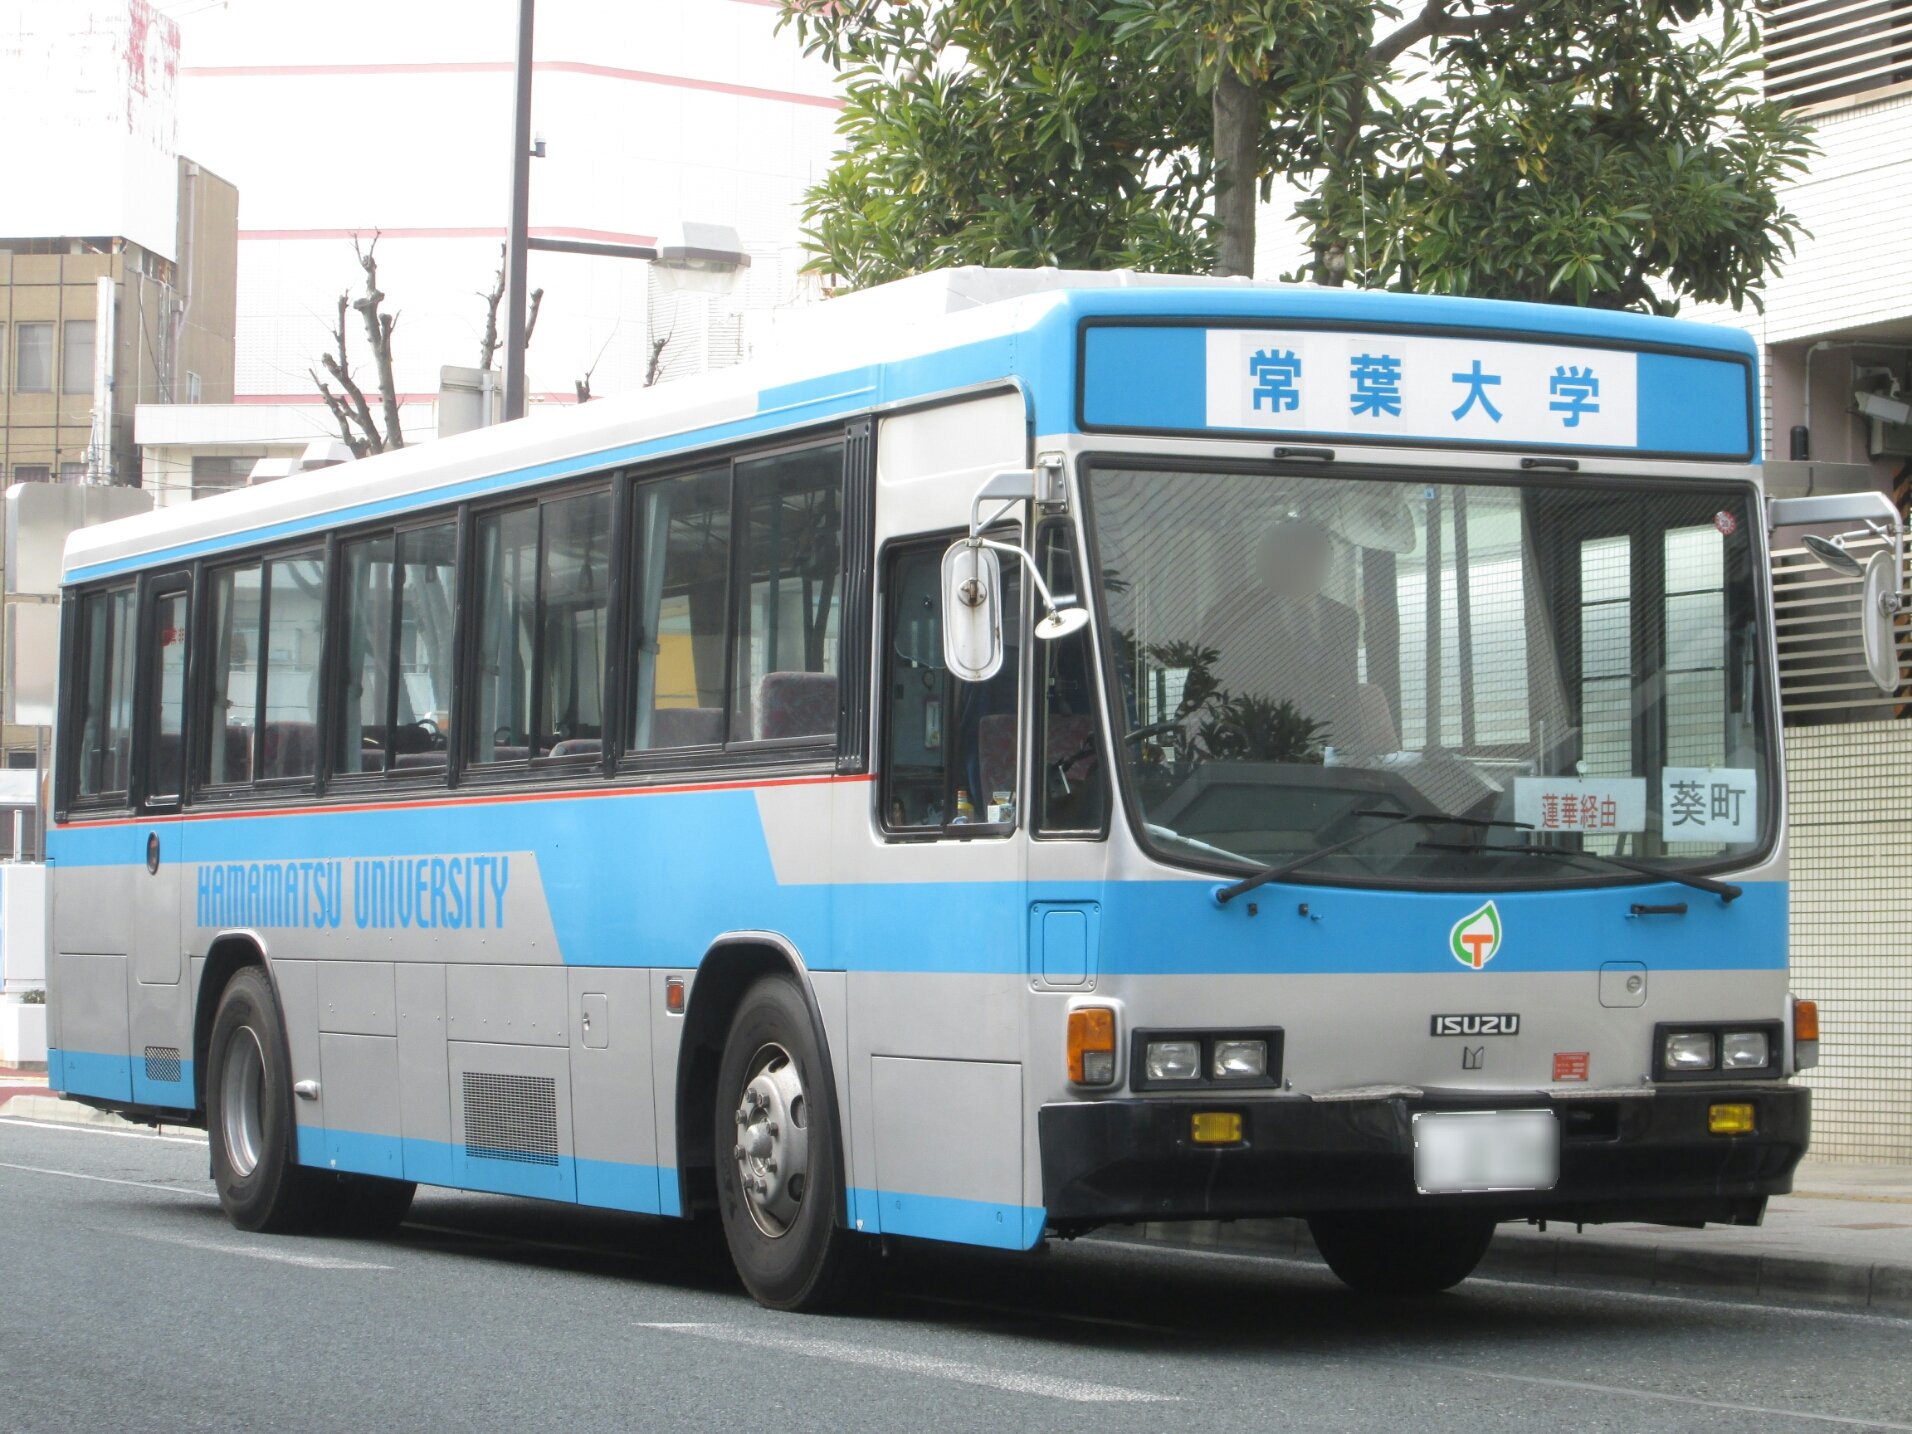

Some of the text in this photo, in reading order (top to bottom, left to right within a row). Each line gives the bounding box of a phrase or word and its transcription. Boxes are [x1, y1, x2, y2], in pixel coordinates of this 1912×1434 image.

[1249, 349, 1600, 428] 常葉大学
[1541, 793, 1617, 829] 蓮華経由
[1670, 780, 1746, 827] 葵町
[196, 856, 509, 929] HAMAMATSU UNIVERSITY
[1436, 1016, 1518, 1035] ISUZU
